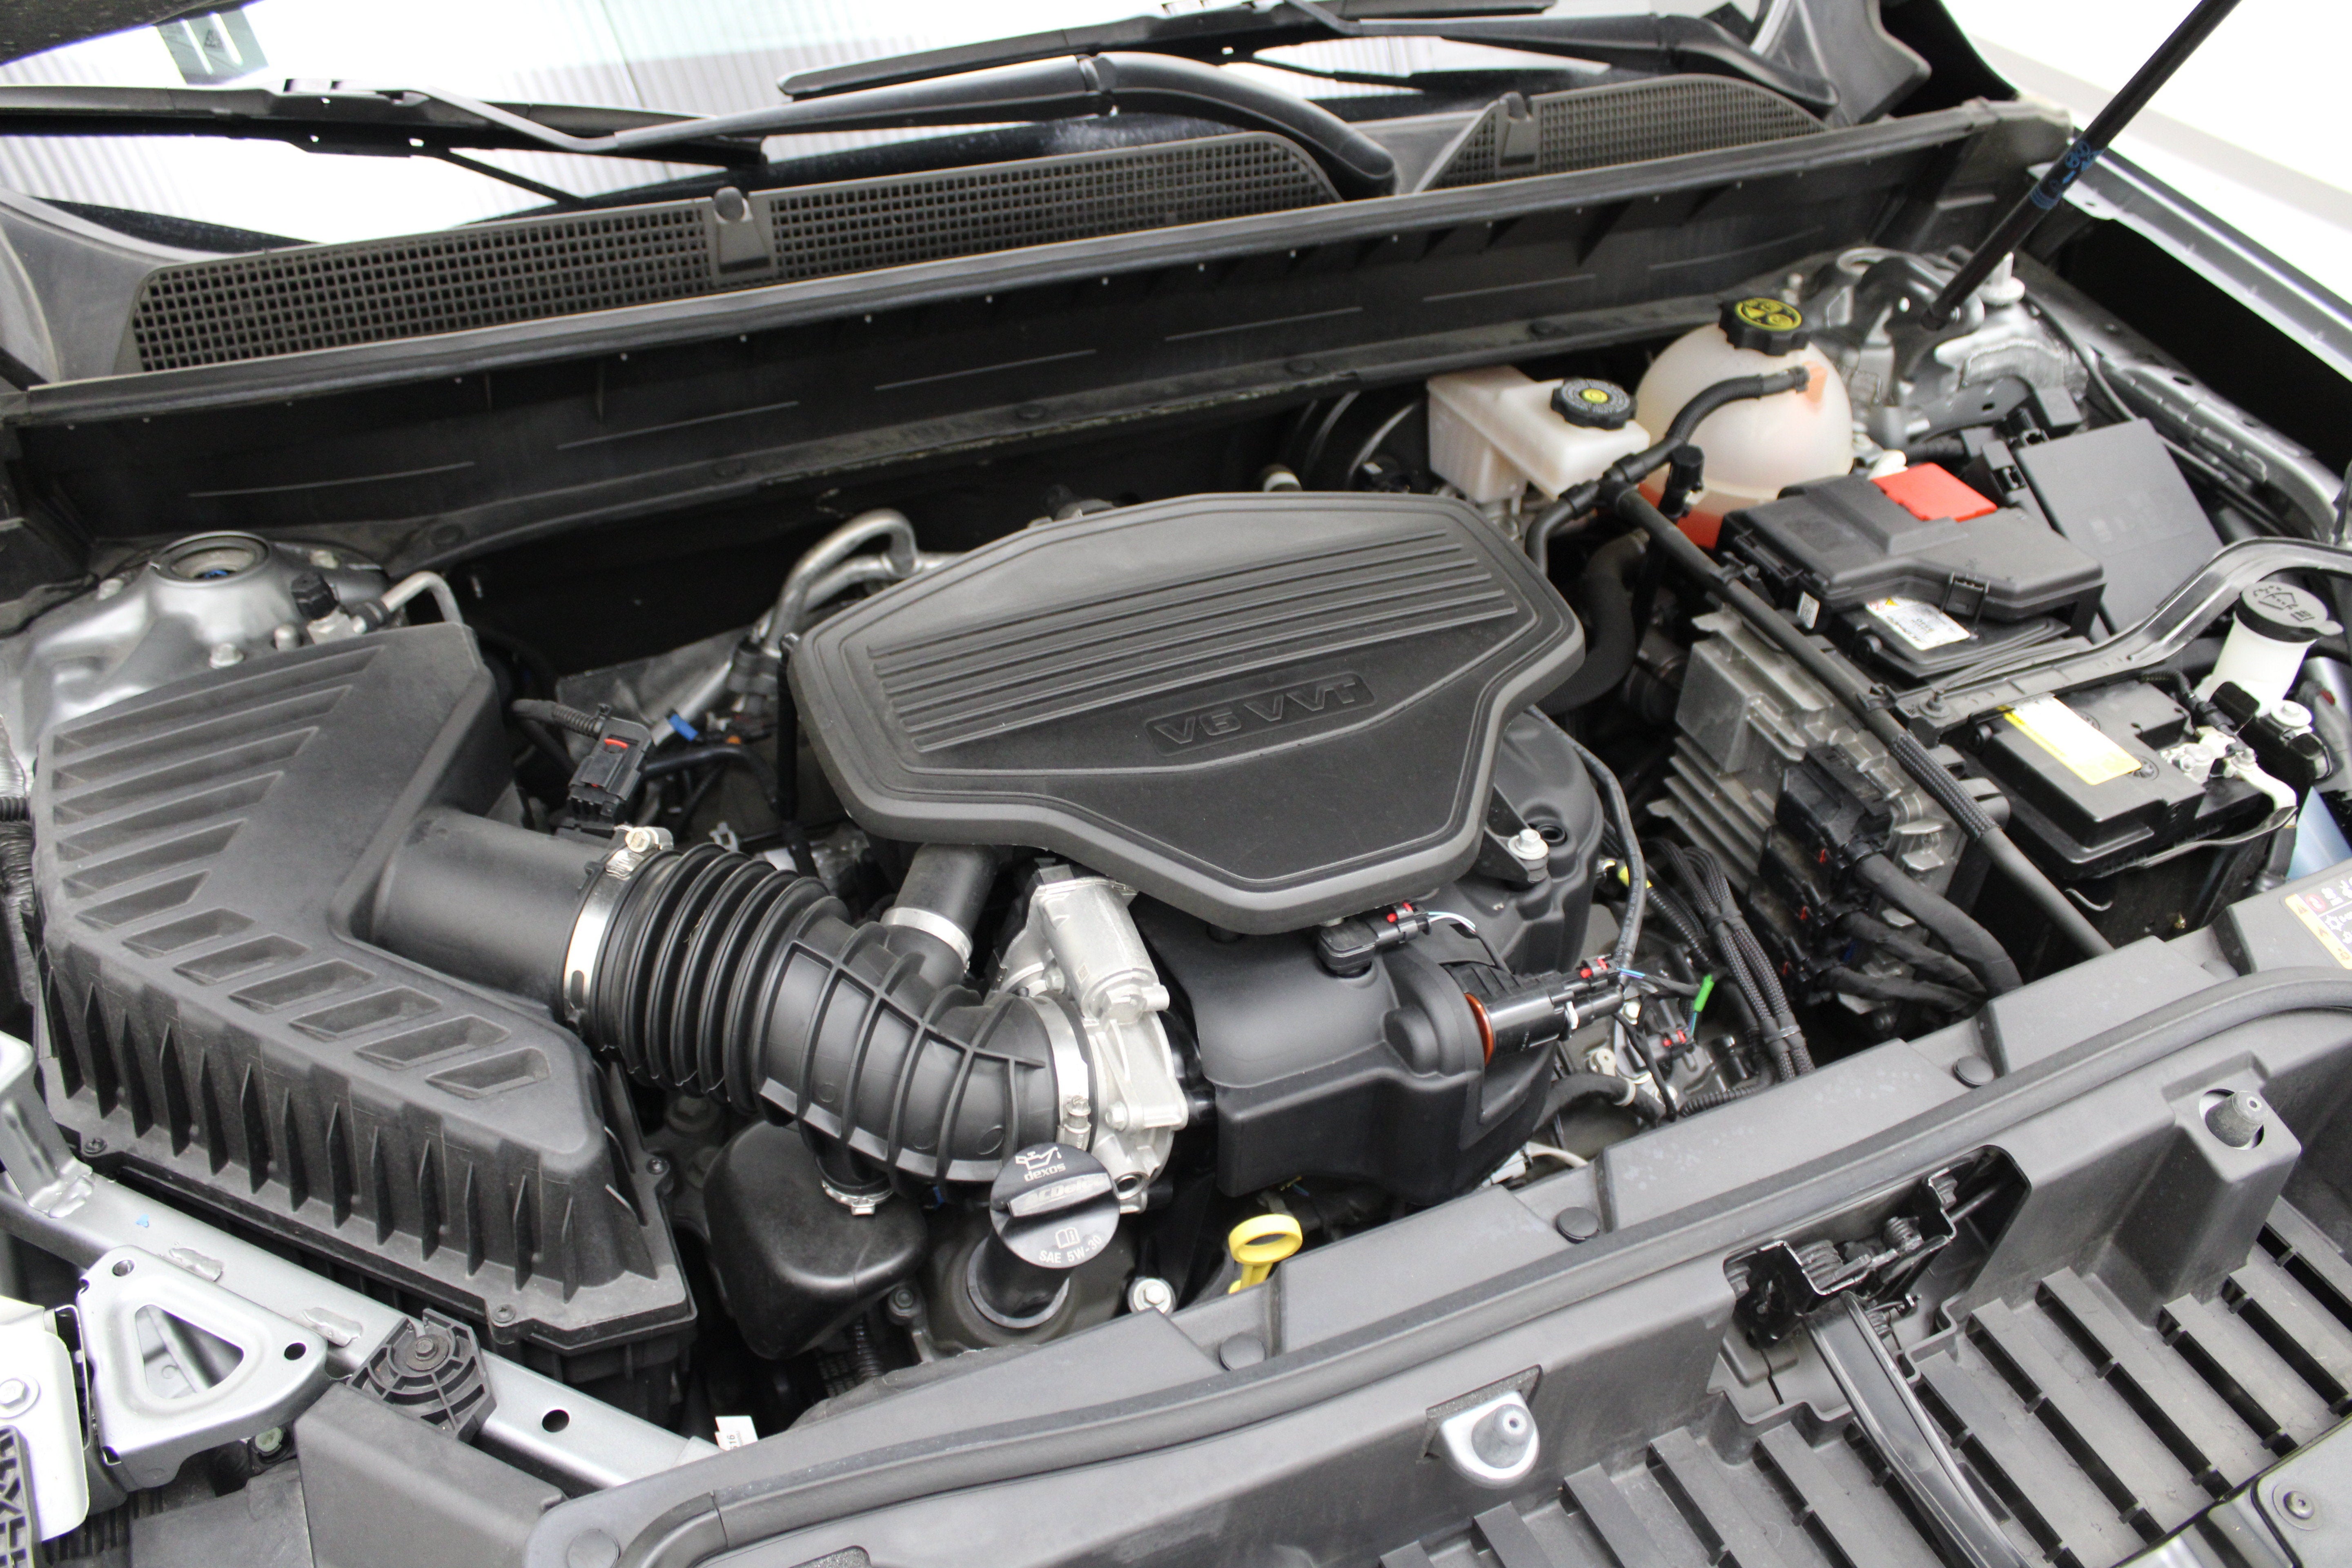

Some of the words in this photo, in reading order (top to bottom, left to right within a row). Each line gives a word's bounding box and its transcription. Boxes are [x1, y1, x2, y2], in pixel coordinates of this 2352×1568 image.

[1155, 708, 1241, 744] V6
[1244, 679, 1356, 722] VVT
[1025, 1163, 1066, 1182] dexos
[1024, 1178, 1103, 1206] ACDelco
[1039, 1250, 1061, 1263] SAE
[1067, 1235, 1102, 1262] 5W-30
